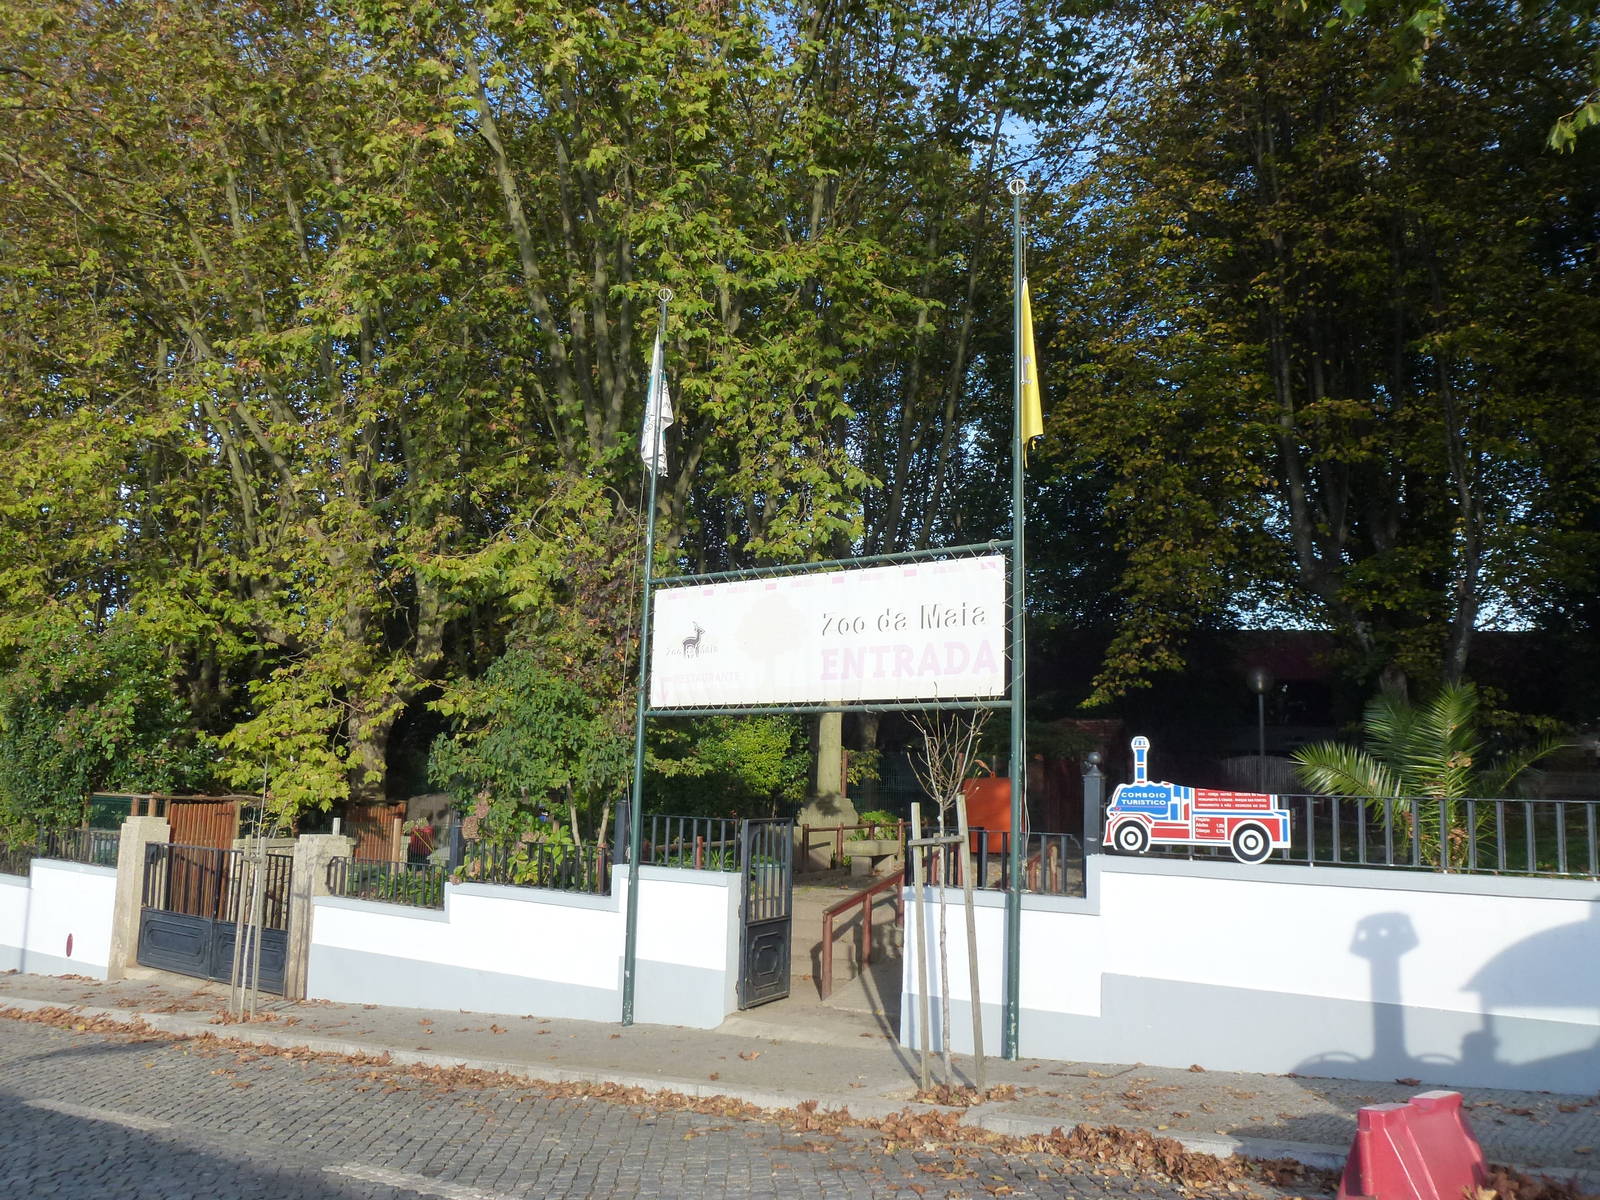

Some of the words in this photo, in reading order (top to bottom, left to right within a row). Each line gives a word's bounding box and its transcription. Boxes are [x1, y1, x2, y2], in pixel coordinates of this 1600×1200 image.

[821, 612, 865, 637] Zoo
[877, 607, 907, 633] da
[920, 601, 986, 630] Maia
[819, 639, 999, 681] ENTRADA
[1121, 791, 1167, 799] COMBOIO
